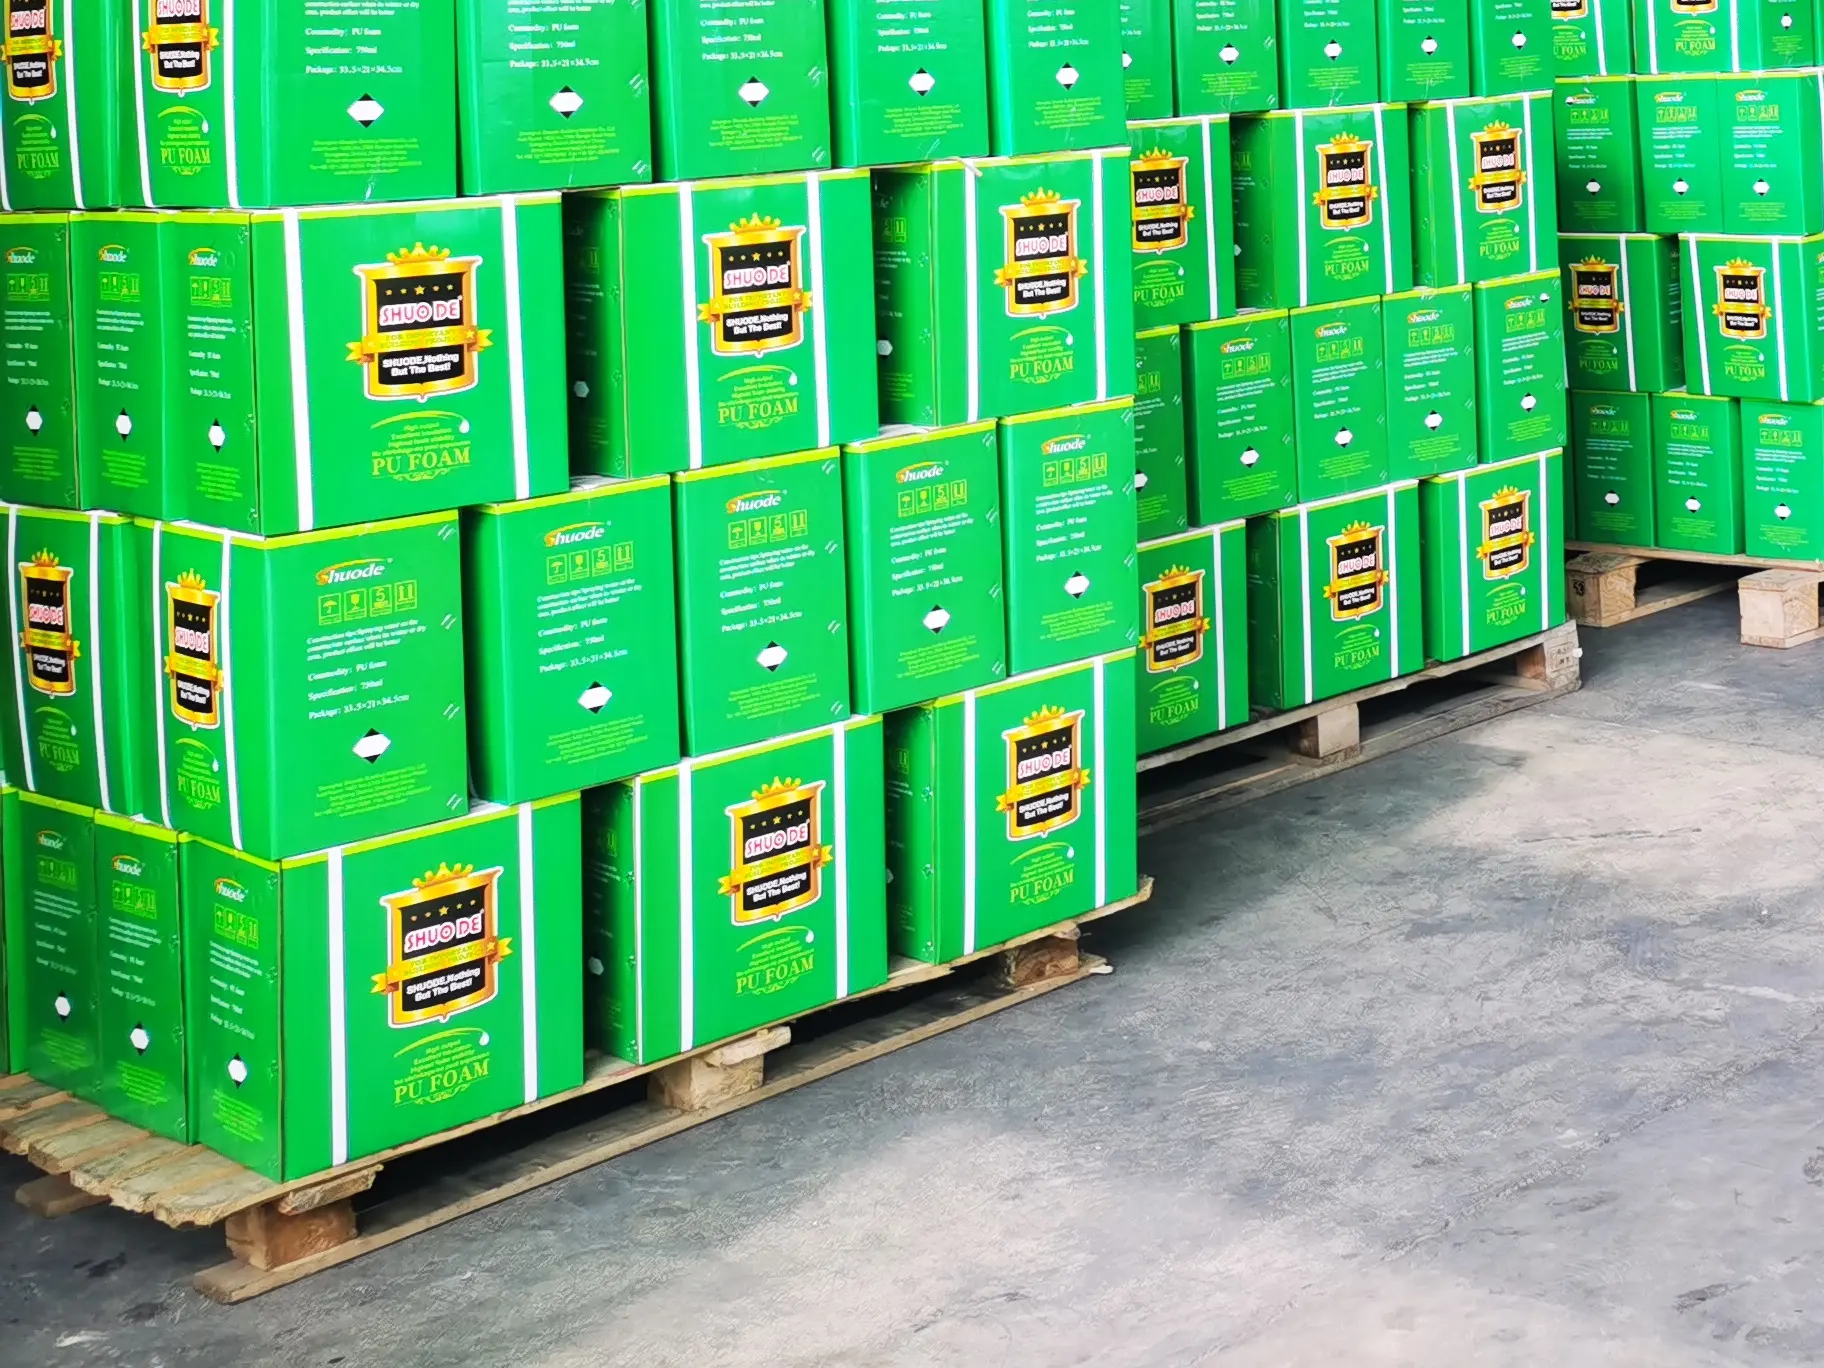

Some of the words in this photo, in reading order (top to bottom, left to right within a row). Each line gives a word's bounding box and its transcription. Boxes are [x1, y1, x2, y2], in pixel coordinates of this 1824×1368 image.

[161, 148, 176, 164] PU
[179, 147, 211, 164] FOAM
[1325, 261, 1340, 275] PU
[1341, 258, 1369, 275] FOAM
[1134, 286, 1151, 303] PU
[1152, 282, 1185, 300] FOAM
[391, 367, 408, 376] But
[409, 365, 426, 374] The
[427, 362, 451, 372] Best!
[1010, 363, 1031, 379] PU
[1034, 355, 1074, 375] FOAM
[718, 403, 744, 423] PU
[749, 396, 799, 419] FOAM
[1041, 436, 1086, 456] Shuode
[372, 456, 401, 475] PU
[408, 447, 470, 471] FOAM
[895, 463, 944, 484] Shuode
[725, 491, 782, 514] Shuode
[544, 522, 605, 547] Shuode
[315, 559, 385, 585] Shuode
[1334, 653, 1350, 669] PU
[1351, 645, 1380, 665] FOAM
[1149, 704, 1167, 724] PU
[1168, 698, 1199, 719] FOAM
[1010, 884, 1029, 903] PU
[1034, 869, 1074, 896] FOAM
[736, 973, 761, 994] PU
[765, 955, 815, 985] FOAM
[433, 985, 449, 997] The
[394, 1080, 422, 1105] PU
[431, 1058, 490, 1093] FOAM
